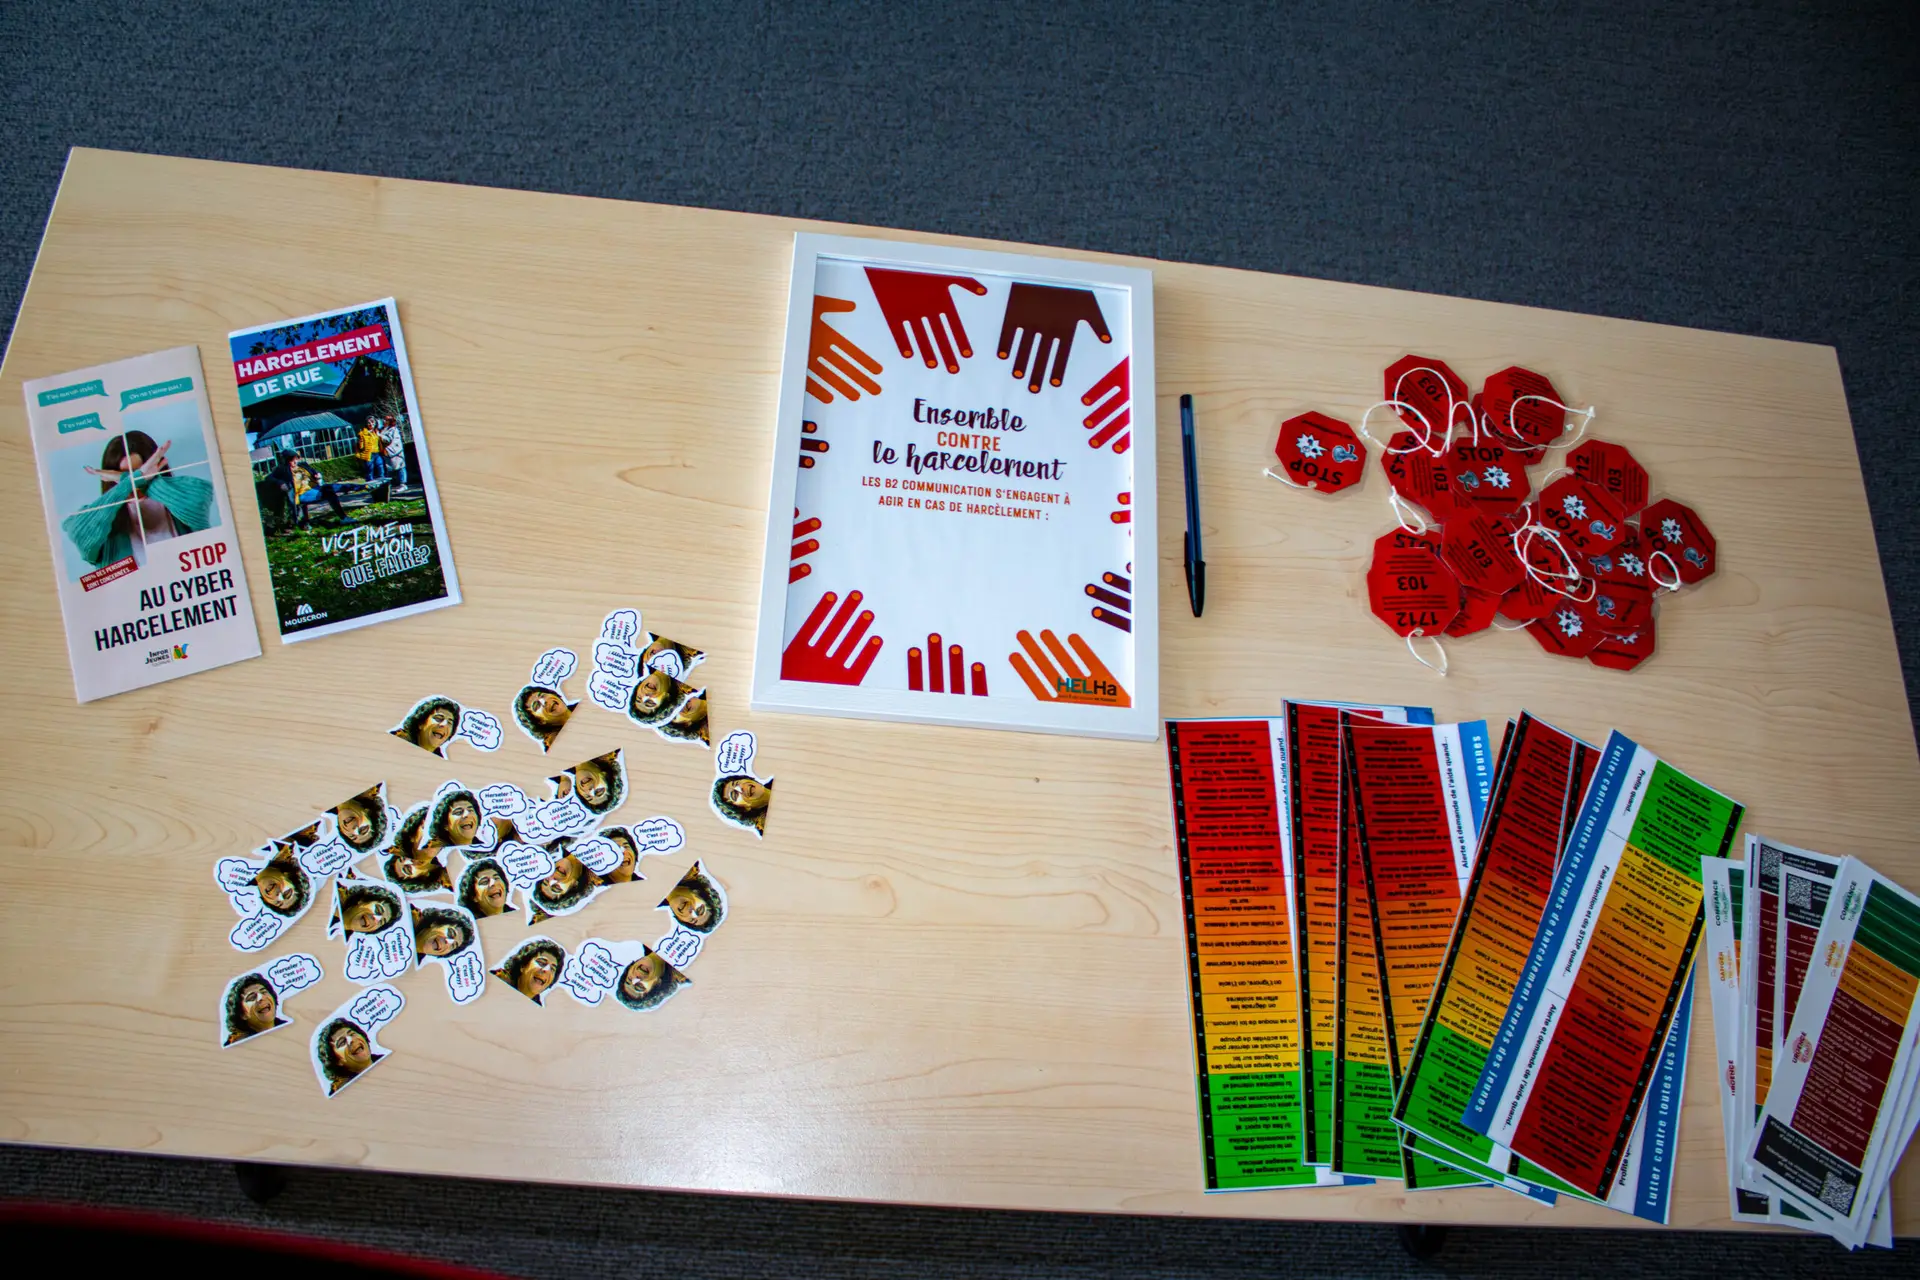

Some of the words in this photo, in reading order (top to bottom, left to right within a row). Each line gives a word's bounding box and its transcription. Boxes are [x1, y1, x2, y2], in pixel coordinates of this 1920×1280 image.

[238, 332, 382, 378] HARCELEMENT
[253, 379, 280, 397] DE
[282, 367, 323, 389] RUE
[1418, 377, 1444, 402] 103
[914, 398, 1026, 432] Ensemble
[873, 440, 898, 464] le
[937, 431, 1001, 451] CONTRE
[1458, 447, 1503, 460] STOP
[1289, 459, 1344, 485] STOP
[1432, 465, 1449, 492] 103
[1608, 468, 1623, 492] 103
[862, 476, 880, 488] LES
[885, 479, 898, 489] B2
[902, 480, 992, 497] COMMUNICATION
[996, 488, 1060, 504] S'ENGAGENT
[1064, 492, 1070, 505] À
[879, 496, 903, 507] AGIR
[908, 498, 921, 509] EN
[925, 500, 945, 511] CAS
[949, 502, 962, 513] DE
[967, 503, 1042, 520] HARCÈLEMENT
[1545, 508, 1590, 548] STOP
[179, 542, 227, 572] STOP
[341, 562, 375, 588] QUE
[376, 545, 430, 577] FAIRE?
[1468, 540, 1493, 568] 103
[140, 586, 165, 611] AU
[170, 569, 234, 603] CYBER
[1398, 576, 1428, 590] 103
[94, 595, 237, 651] HARCELEMENT
[285, 612, 328, 627] MOUSCRON
[1396, 612, 1438, 627] 1712
[1057, 678, 1117, 696] HELHa
[1469, 735, 1486, 777] jeunes
[1605, 745, 1624, 777] Lutter
[1446, 767, 1455, 788] l'aide
[1632, 768, 1646, 790] Profite
[1450, 789, 1456, 799] de
[1591, 778, 1611, 813] contre
[1451, 799, 1463, 835] demande
[1458, 835, 1464, 844] et
[1576, 814, 1597, 850] toutes
[1459, 845, 1468, 868] Alerte
[1569, 851, 1584, 869] les
[1599, 864, 1610, 880] Fais
[1554, 870, 1576, 910] formes
[1588, 880, 1604, 908] attention
[1585, 908, 1593, 917] et
[1711, 880, 1721, 926] CONFIANCE
[1548, 912, 1560, 927] de
[1580, 916, 1590, 929] dis
[1573, 929, 1586, 949] STOP
[1519, 928, 1554, 1002] harcèlement
[377, 999, 386, 1007] pas
[1542, 1003, 1557, 1026] Alerte
[1500, 1002, 1525, 1045] auprès
[1539, 1026, 1548, 1035] et
[1665, 1004, 1681, 1046] form
[1491, 1045, 1507, 1069] des
[1525, 1034, 1545, 1069] demande
[1663, 1050, 1675, 1070] les
[1522, 1068, 1531, 1080] de
[1473, 1069, 1498, 1114] jeunes
[1514, 1079, 1527, 1101] l'aide
[1656, 1074, 1673, 1115] toutes
[1650, 1119, 1667, 1162] contre
[1646, 1166, 1661, 1205] Lutter
